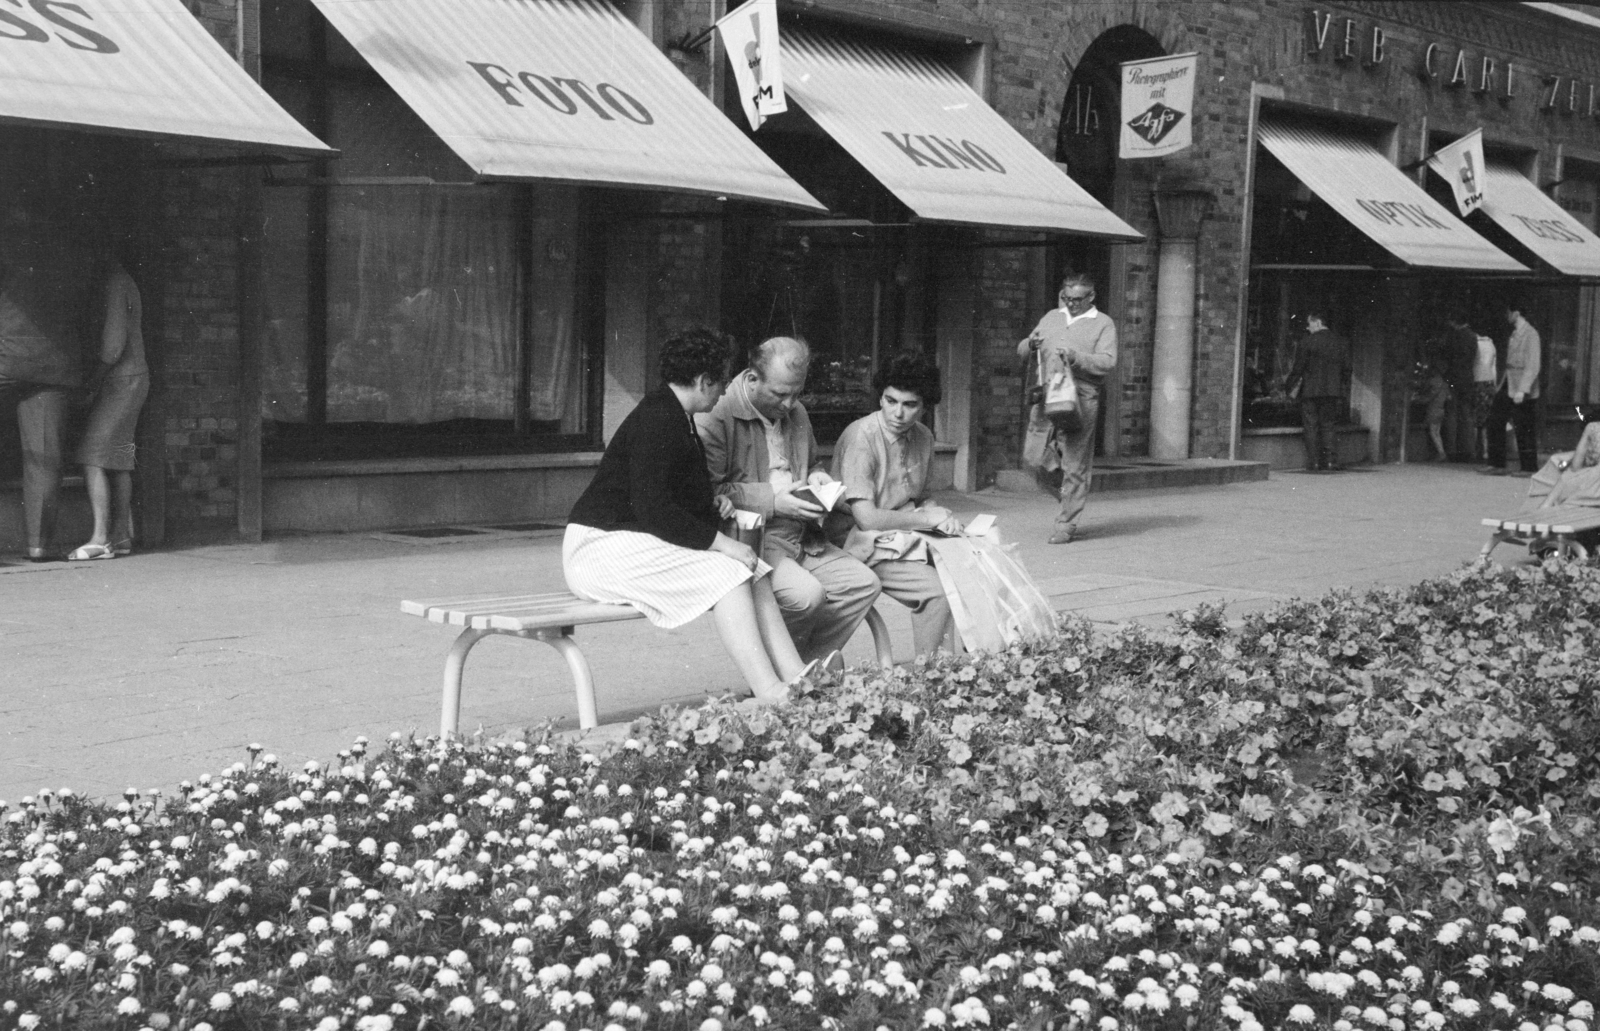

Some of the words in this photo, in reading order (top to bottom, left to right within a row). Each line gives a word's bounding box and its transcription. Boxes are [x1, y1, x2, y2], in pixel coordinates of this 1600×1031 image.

[1312, 10, 1385, 63] VEB
[1425, 42, 1515, 96] CARL
[465, 60, 655, 125] FOTO
[1150, 87, 1166, 99] mit
[1131, 108, 1175, 140] Agfa
[881, 131, 1006, 174] KINO
[1356, 198, 1452, 231] OPTIK
